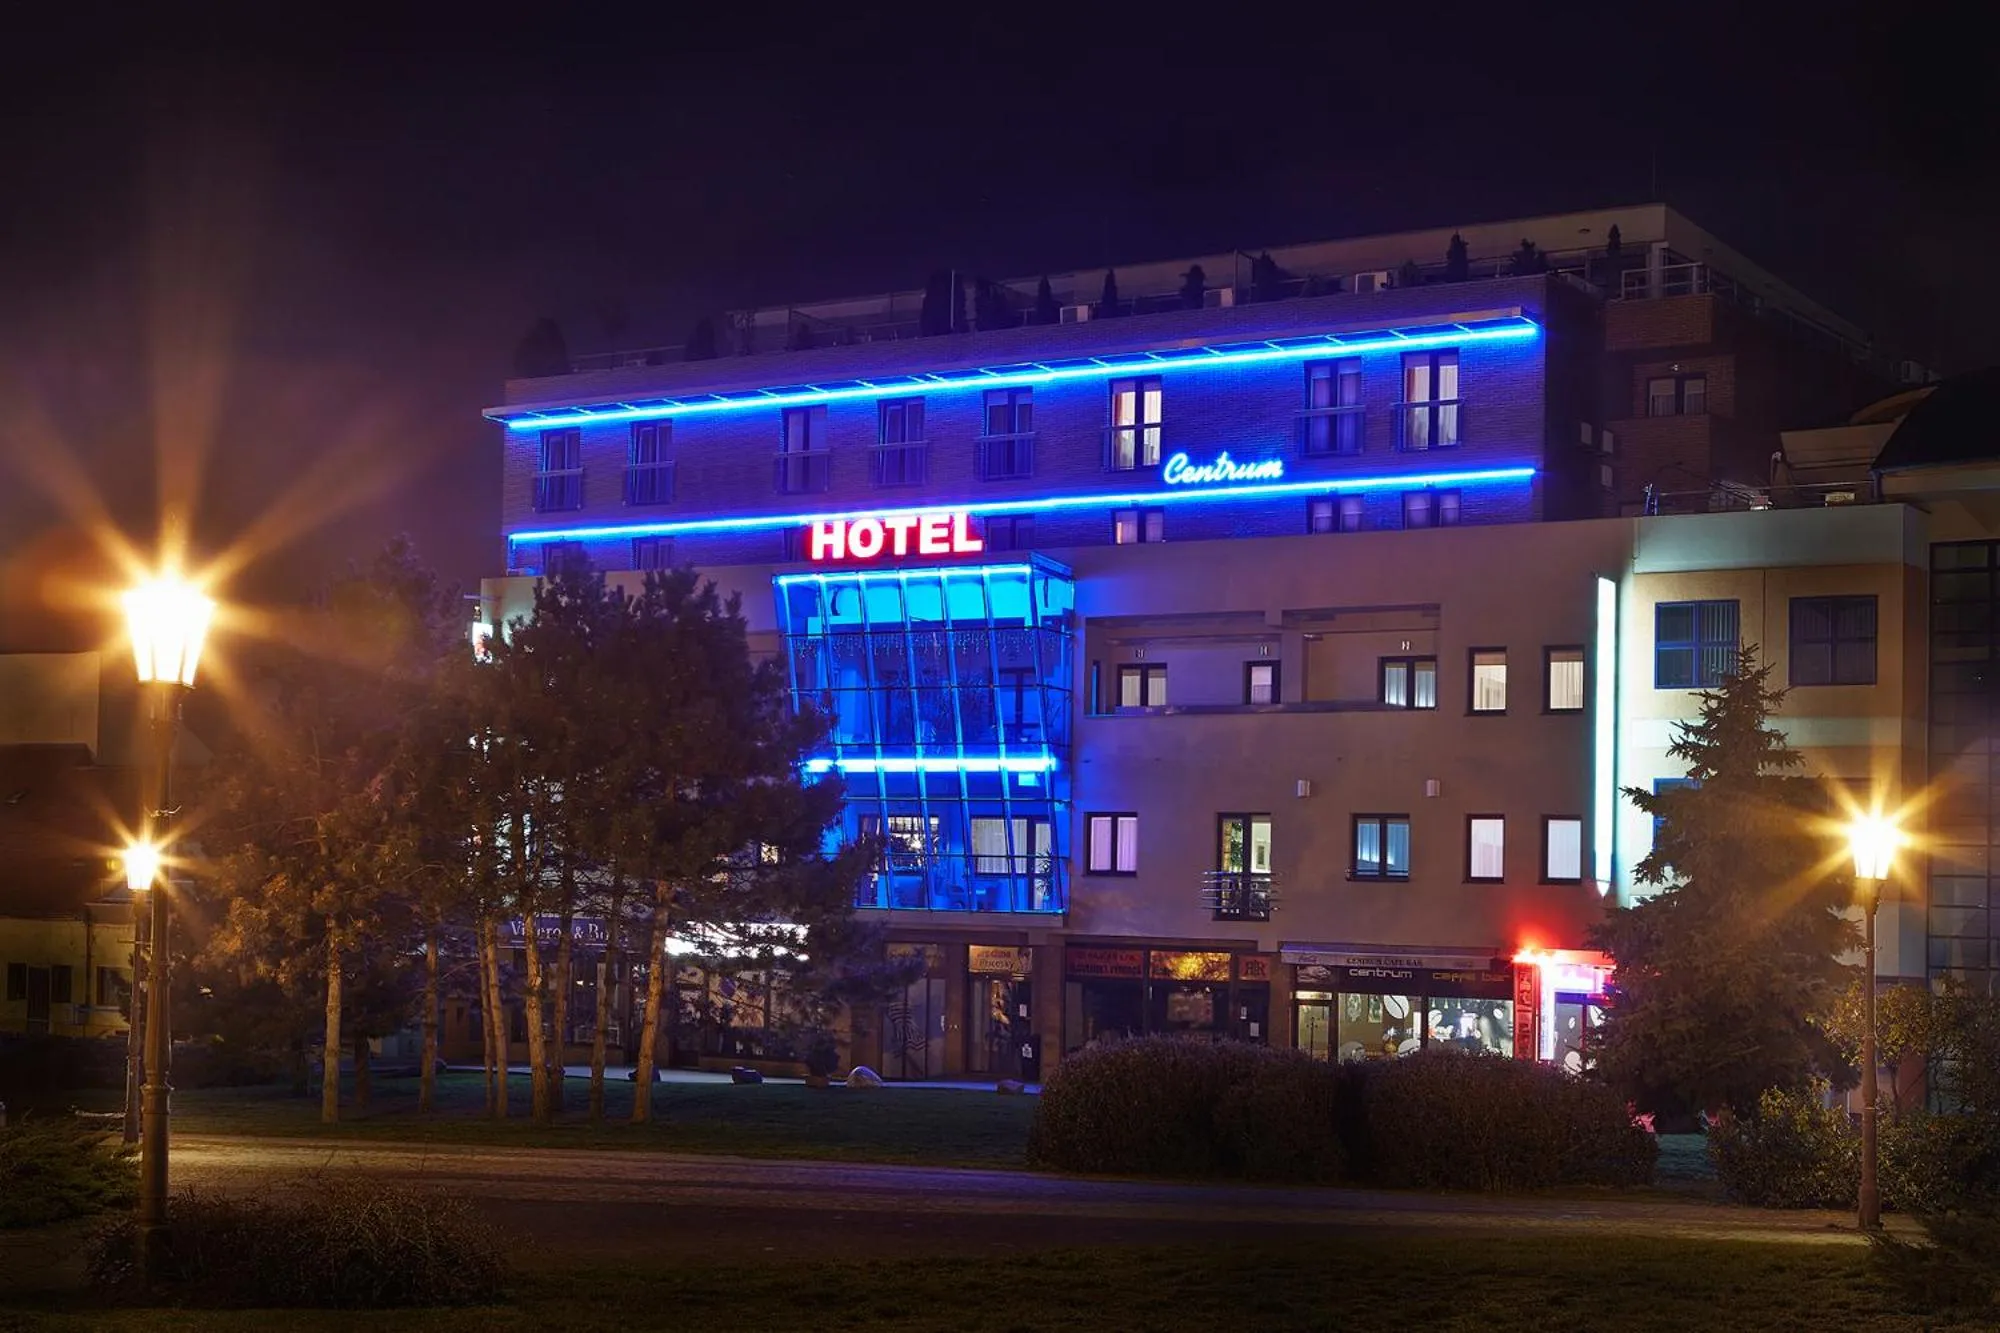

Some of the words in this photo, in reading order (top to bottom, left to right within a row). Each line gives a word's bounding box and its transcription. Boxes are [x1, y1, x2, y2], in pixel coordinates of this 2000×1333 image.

[1163, 451, 1284, 484] Centrum
[812, 512, 983, 560] HOTEL
[574, 926, 584, 939] &
[1349, 967, 1413, 979] centrum
